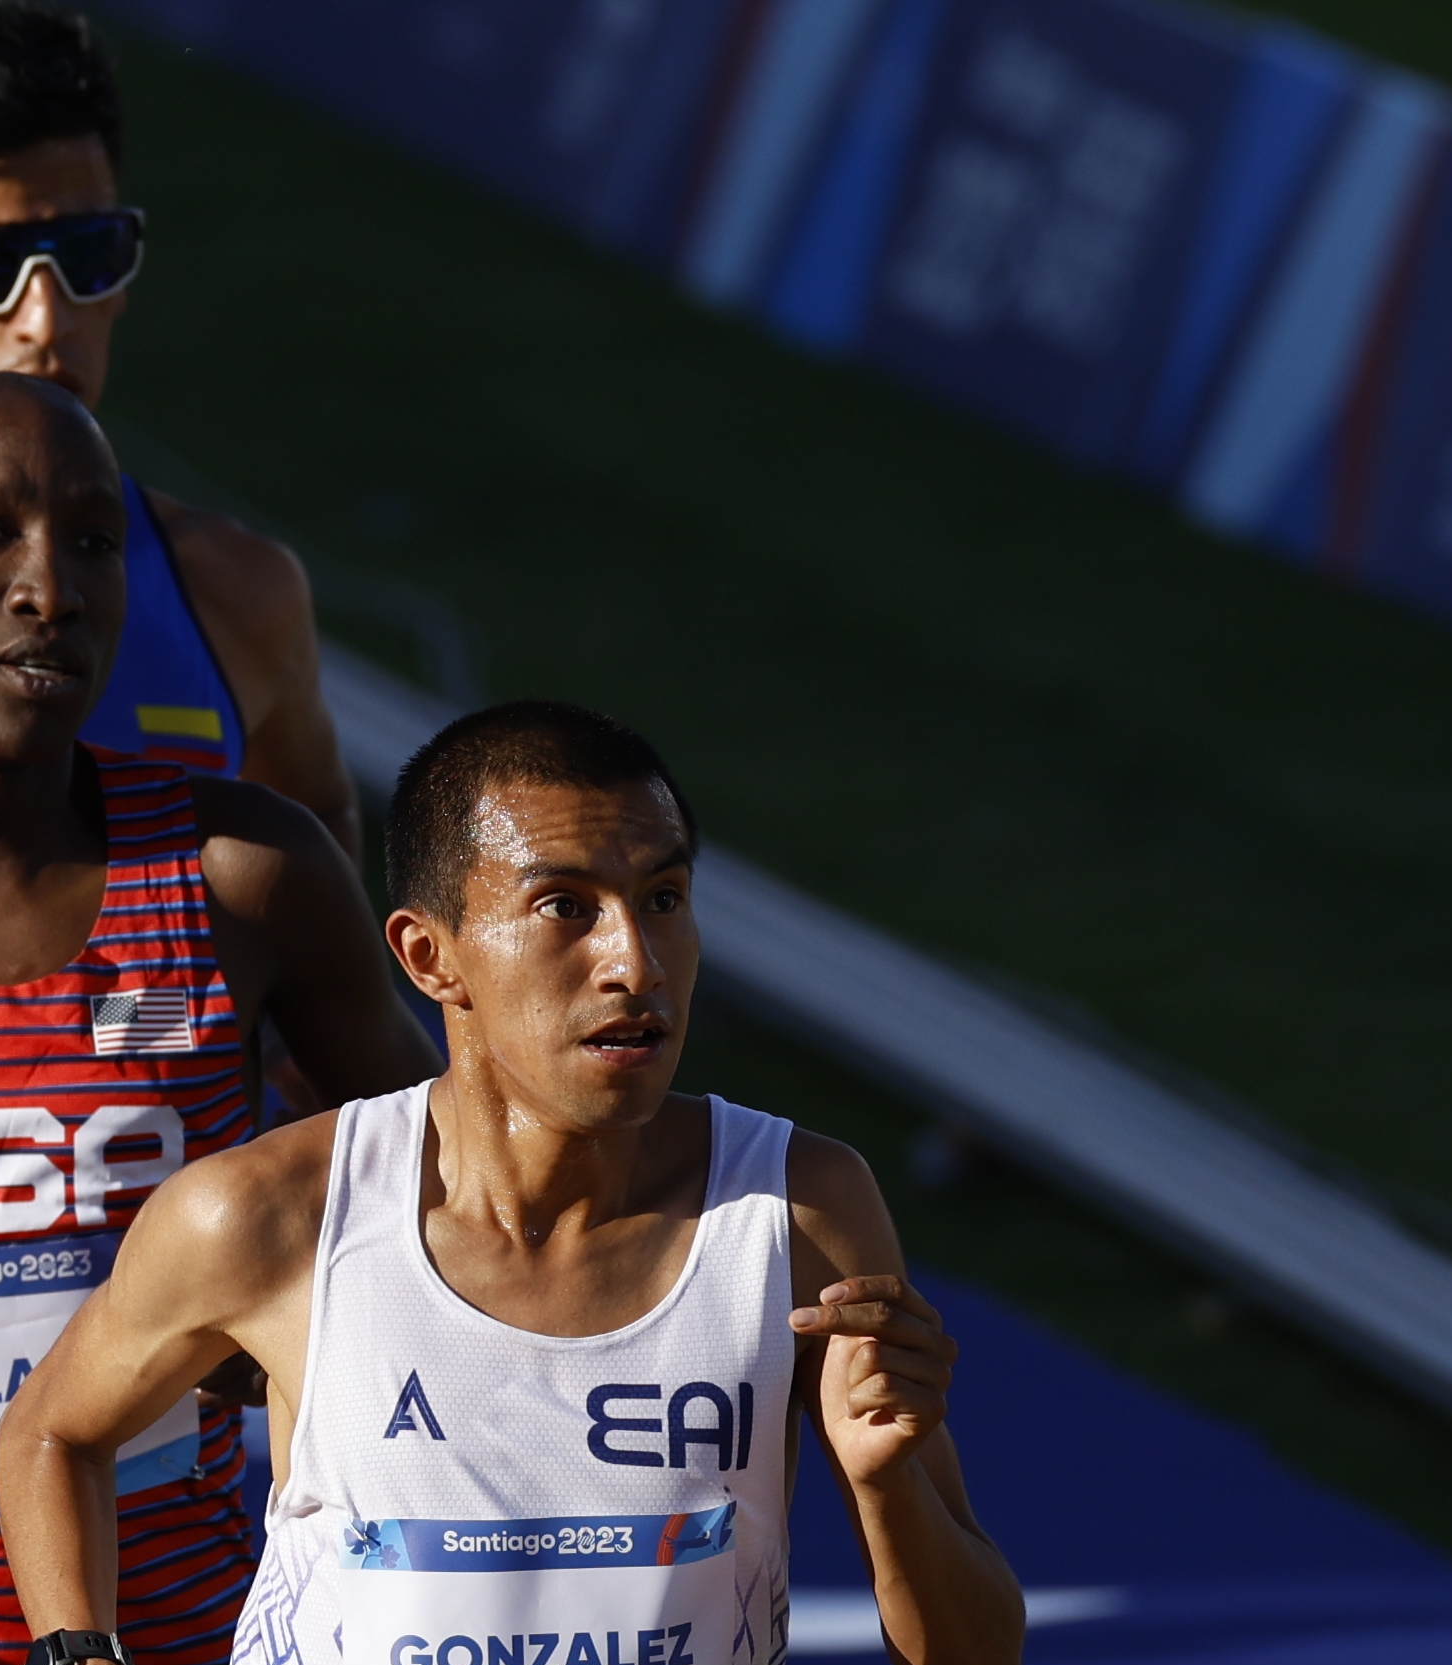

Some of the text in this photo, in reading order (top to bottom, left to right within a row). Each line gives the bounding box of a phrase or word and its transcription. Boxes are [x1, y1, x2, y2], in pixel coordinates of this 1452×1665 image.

[19, 1248, 92, 1281] 2023
[442, 1526, 635, 1557] Santiago 2023
